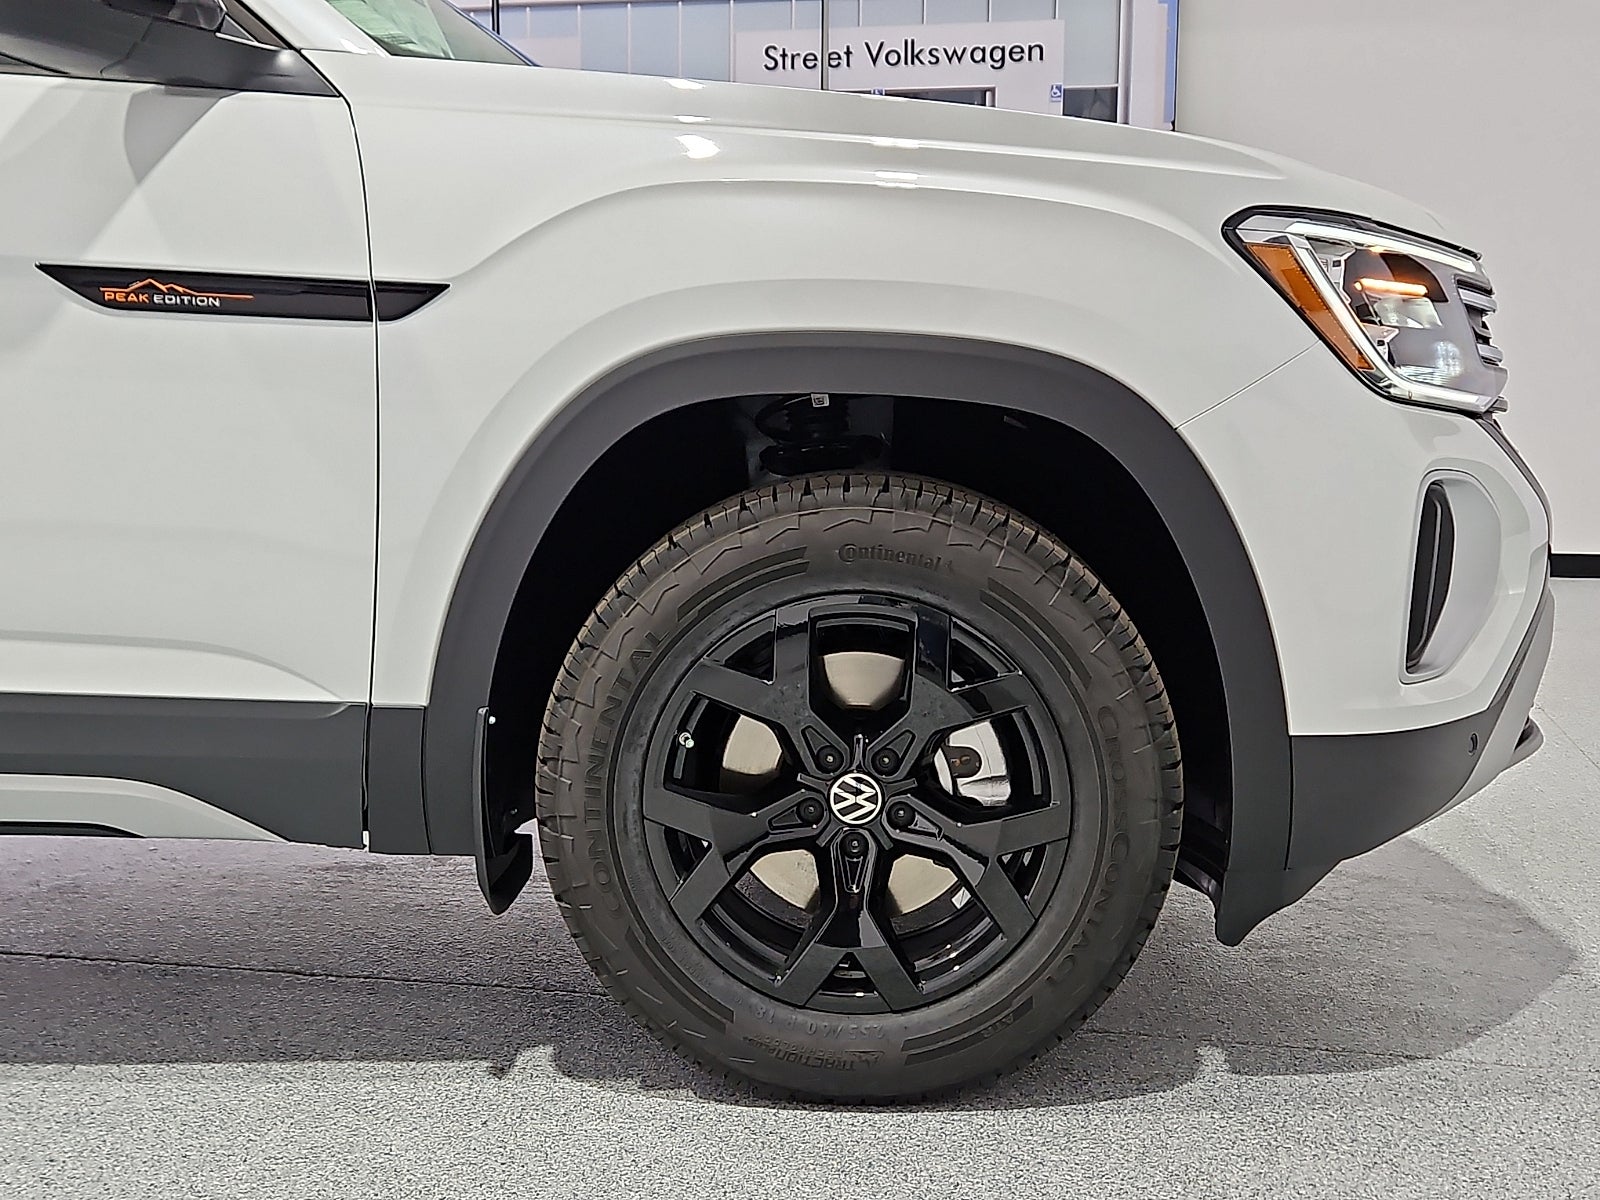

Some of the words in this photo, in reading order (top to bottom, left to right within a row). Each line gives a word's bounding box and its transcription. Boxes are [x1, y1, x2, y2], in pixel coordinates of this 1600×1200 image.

[763, 45, 853, 71] Street
[864, 38, 1044, 69] Volkswagen
[104, 291, 149, 303] PEAK
[153, 294, 221, 307] EDITION
[583, 630, 670, 920] CONTINENTAL
